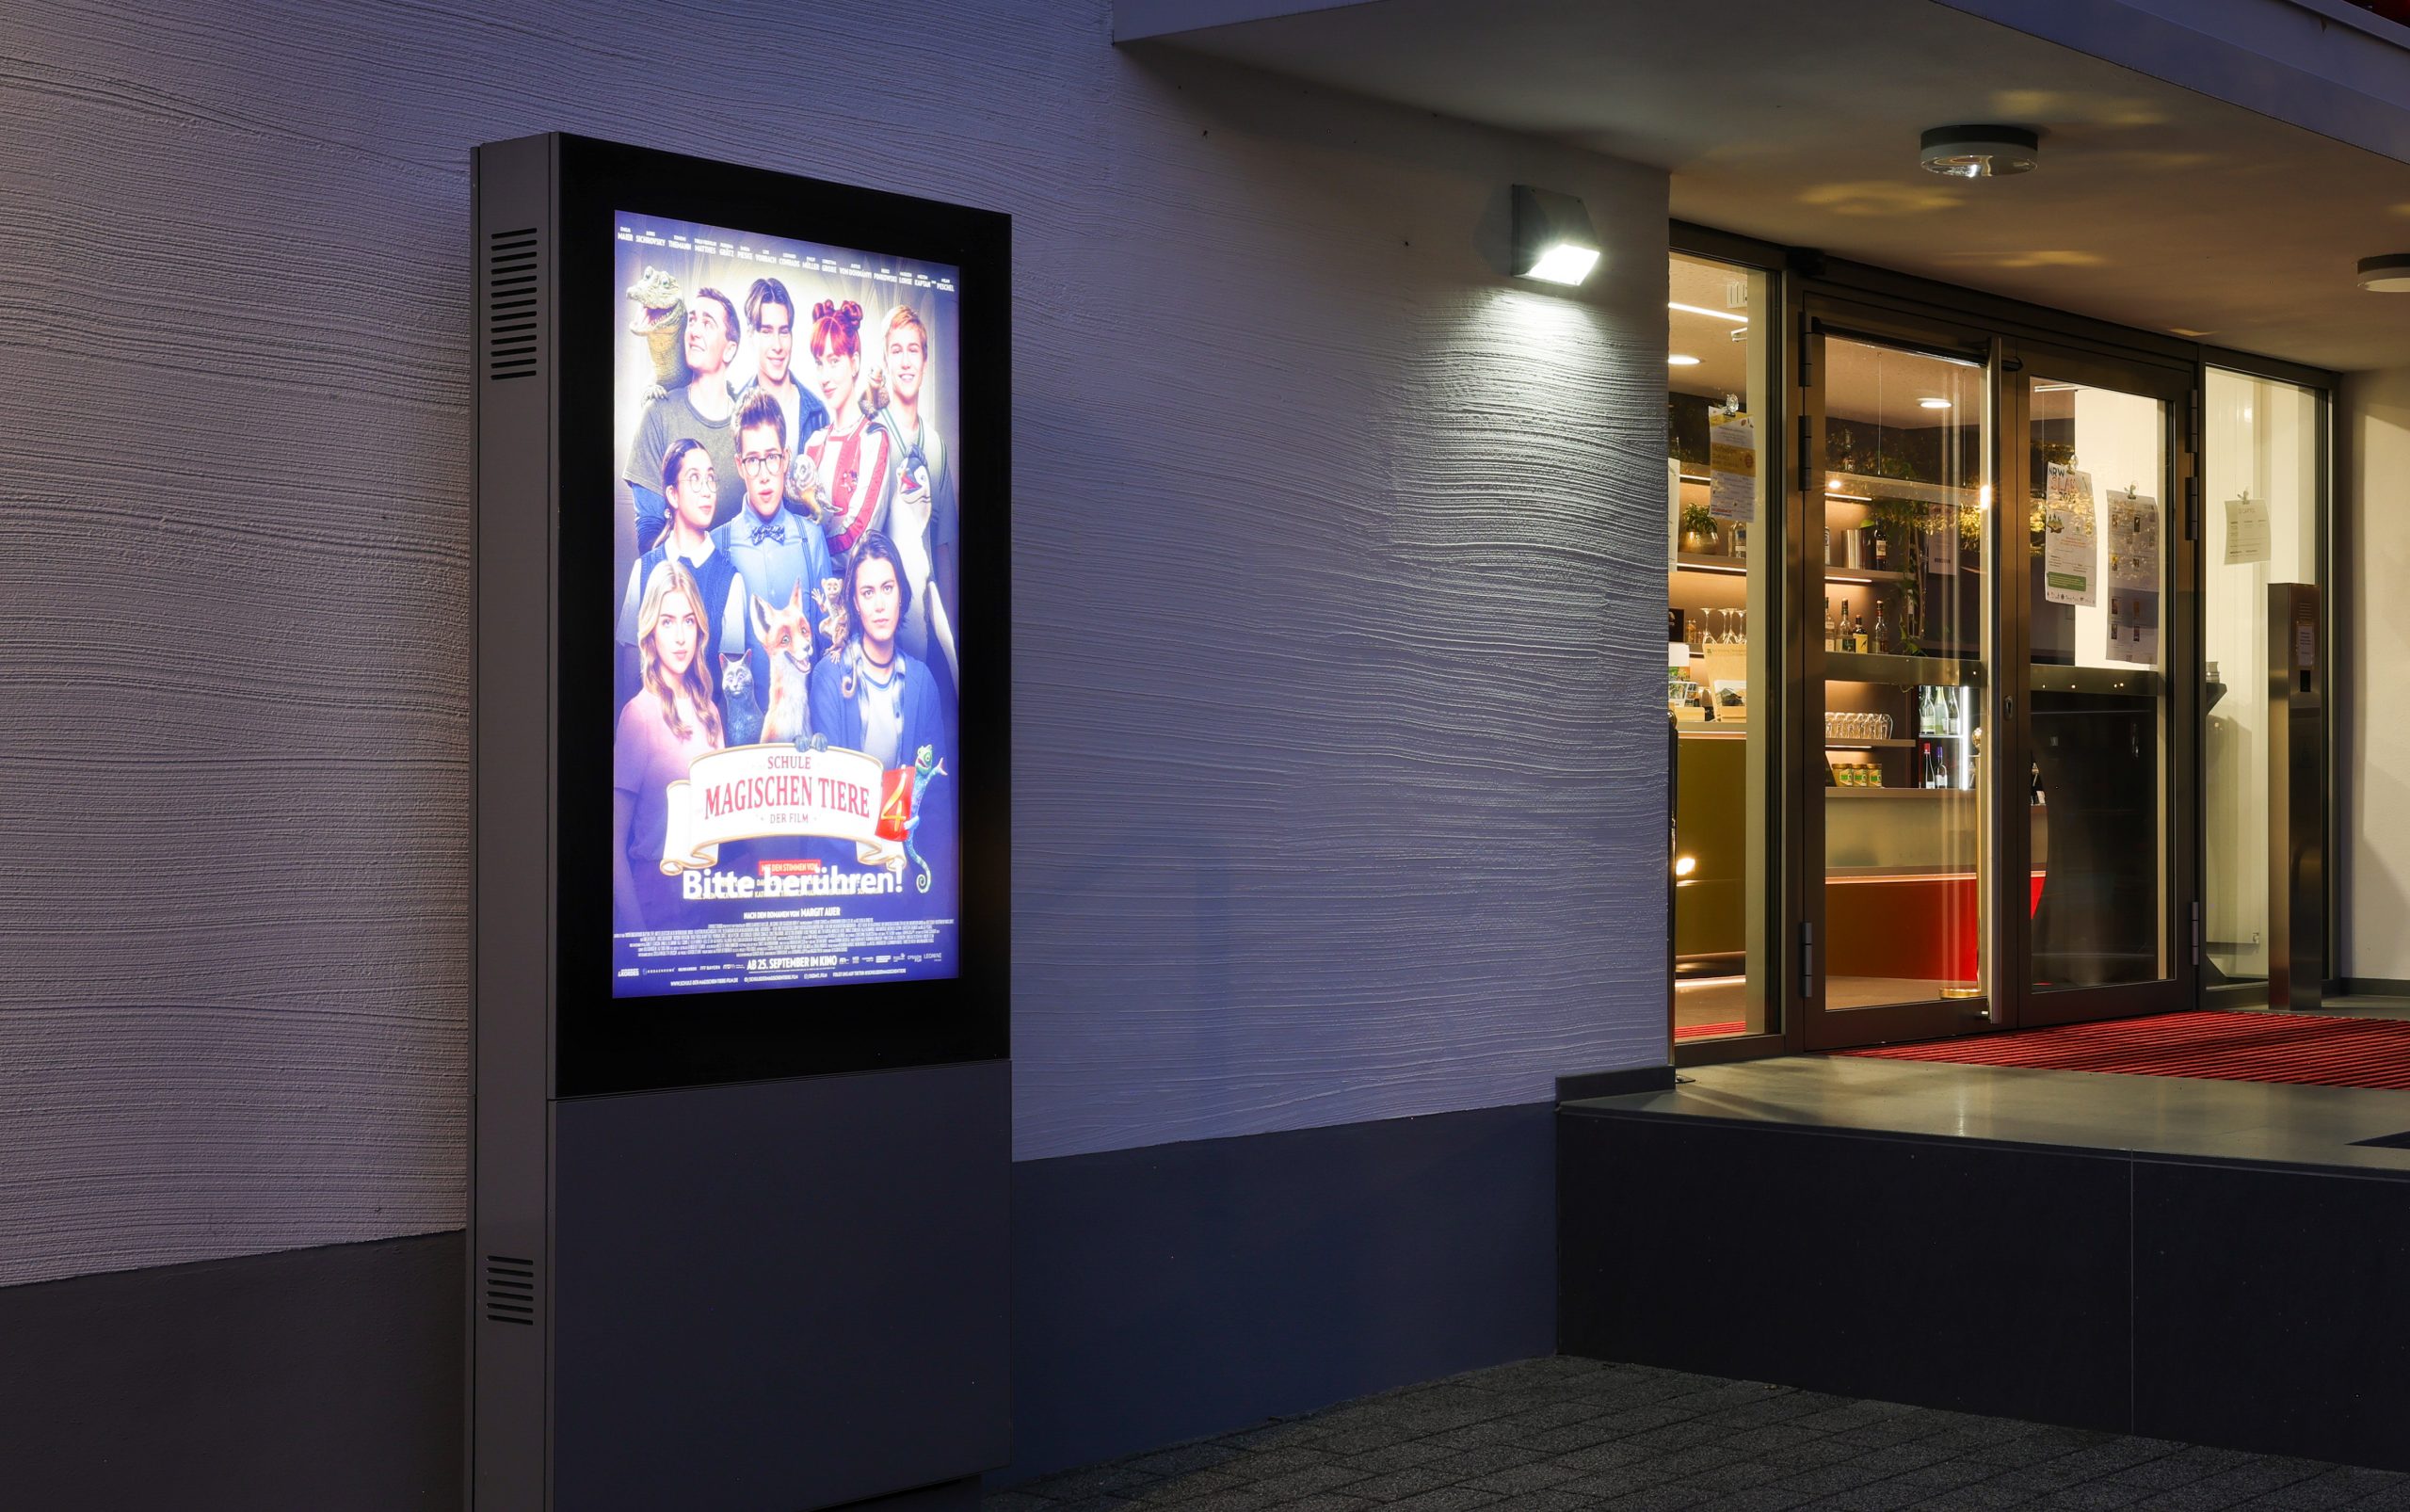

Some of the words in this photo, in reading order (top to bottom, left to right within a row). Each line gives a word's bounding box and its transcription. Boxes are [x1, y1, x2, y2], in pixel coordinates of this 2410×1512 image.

[2048, 467, 2065, 477] NRW
[767, 755, 811, 770] SCHULE
[704, 775, 812, 820] MAGISCHEN
[818, 777, 870, 818] TIERE
[880, 772, 907, 832] 4
[769, 813, 786, 824] DER
[789, 812, 809, 824] FILM
[683, 868, 755, 900] Bitte
[763, 865, 903, 898] berühren!
[800, 908, 824, 917] MARGIT
[825, 907, 841, 916] AUER
[747, 959, 757, 970] AB
[758, 958, 768, 970] 25.
[769, 957, 809, 969] SEPTEMBER
[811, 957, 818, 967] IM
[820, 955, 837, 966] KINO
